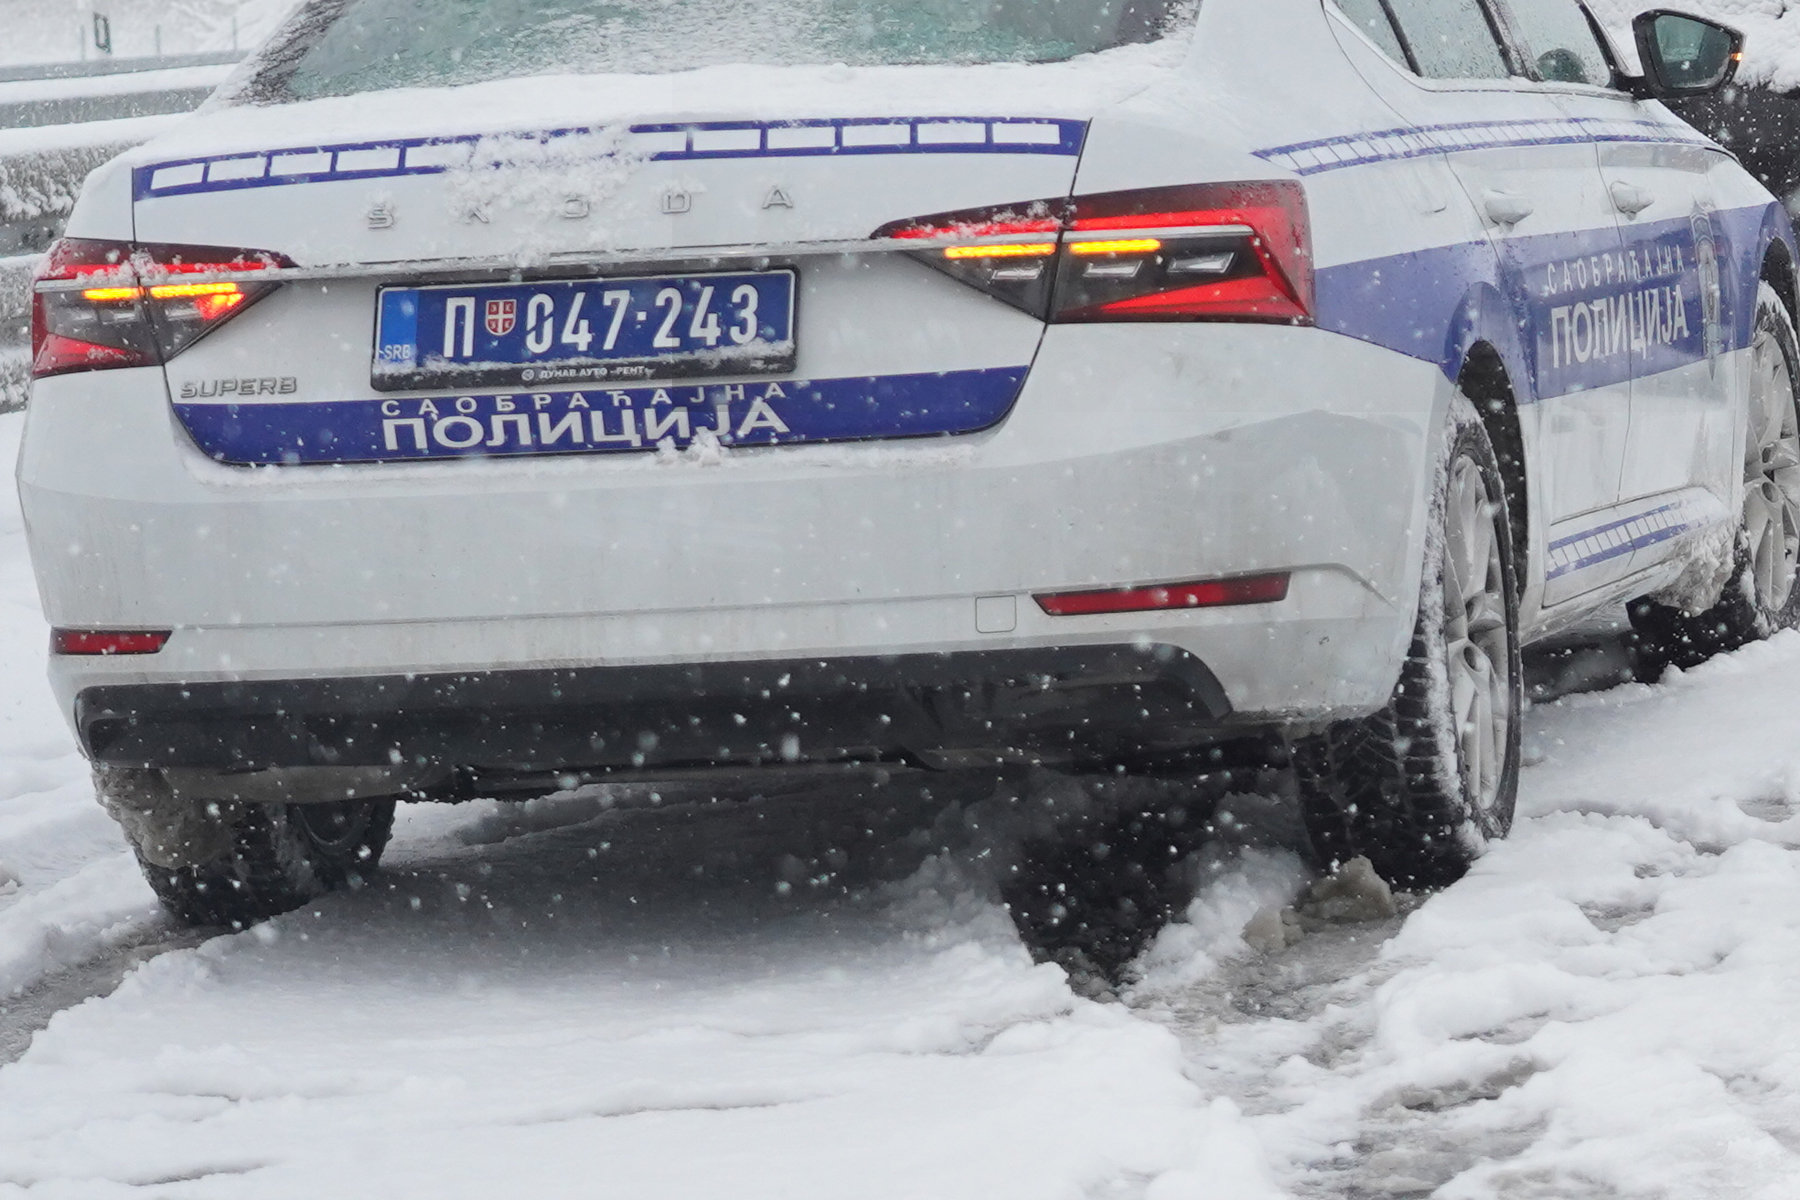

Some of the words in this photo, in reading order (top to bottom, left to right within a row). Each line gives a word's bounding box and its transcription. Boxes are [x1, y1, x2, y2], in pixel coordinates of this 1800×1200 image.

[442, 296, 478, 358] П
[1551, 284, 1690, 369] ПОЛИЦИЈА
[384, 344, 411, 360] SRB
[181, 376, 298, 399] SUPERB
[381, 382, 786, 416] САОБРАЋАЈНА
[382, 399, 791, 450] ПОЛИЦИЈА
